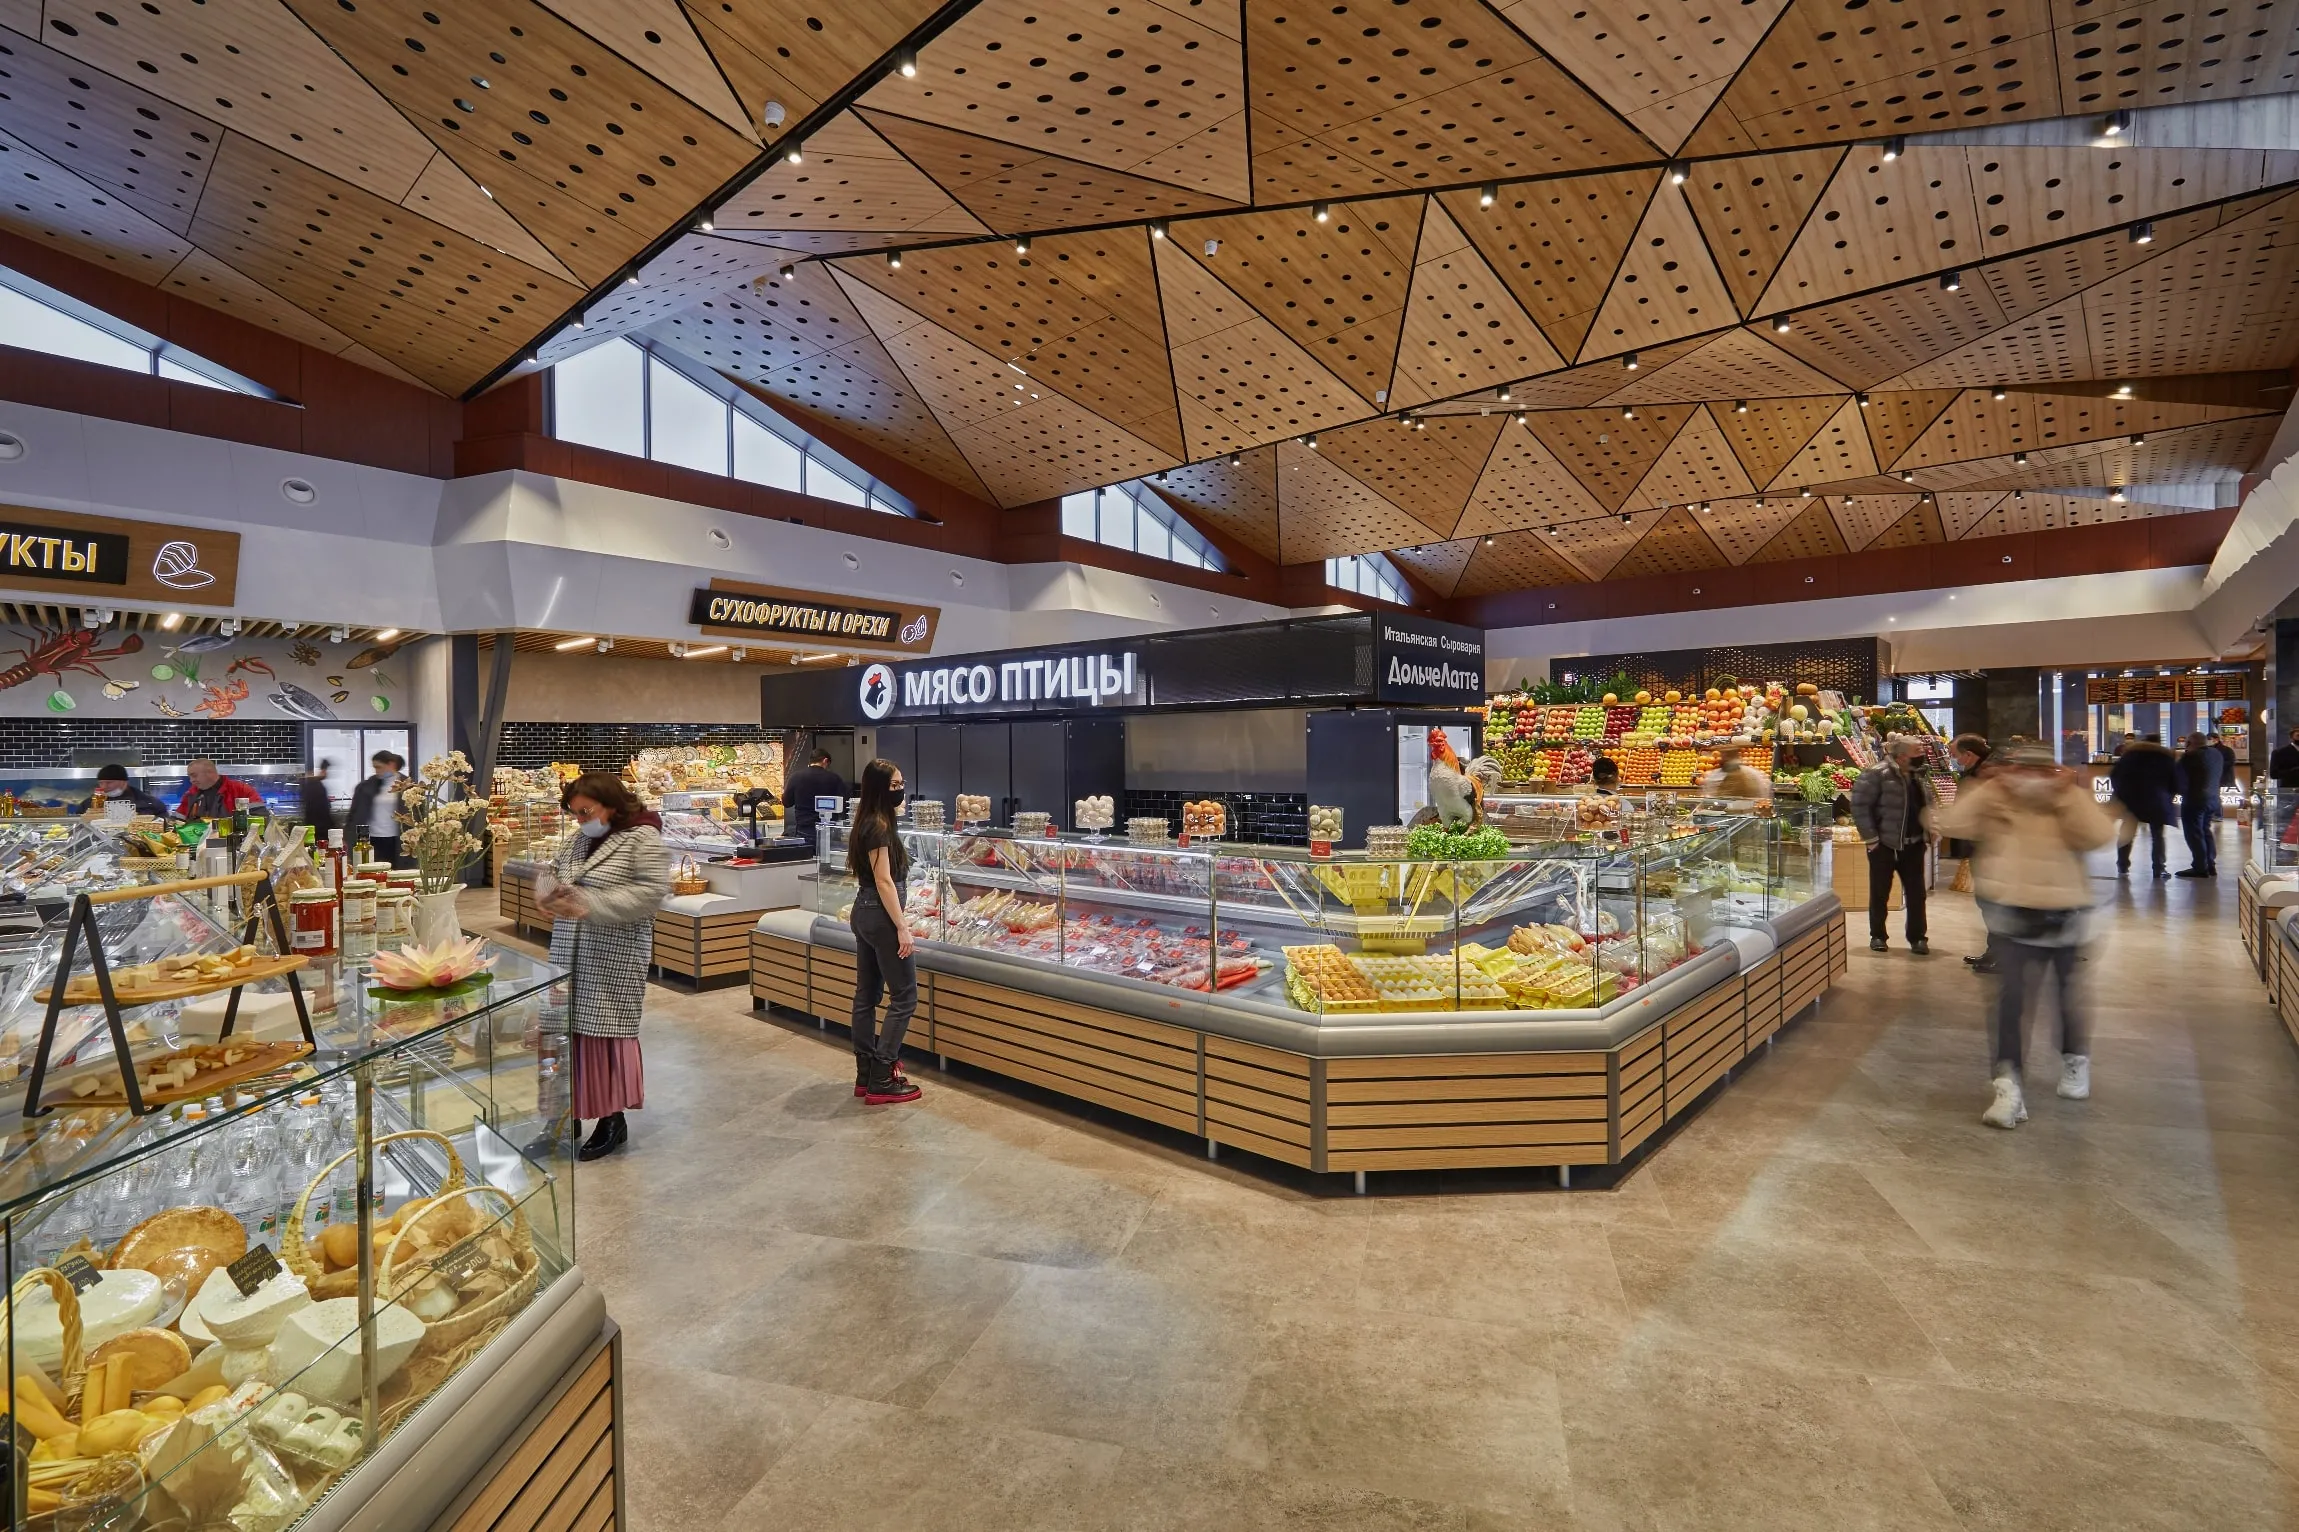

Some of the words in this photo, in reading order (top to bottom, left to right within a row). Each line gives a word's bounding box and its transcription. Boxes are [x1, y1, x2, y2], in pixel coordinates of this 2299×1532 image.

[709, 597, 827, 631] СУХОФРУКТЫ
[828, 611, 842, 632] И
[843, 613, 891, 636] ОРЕХИ
[1384, 625, 1438, 648] Итальянская
[1440, 635, 1481, 656] Сыроварня
[904, 665, 994, 707] МЯСО
[1001, 652, 1134, 707] ПТИЦЫ
[1387, 655, 1479, 692] ДольчеЛатте
